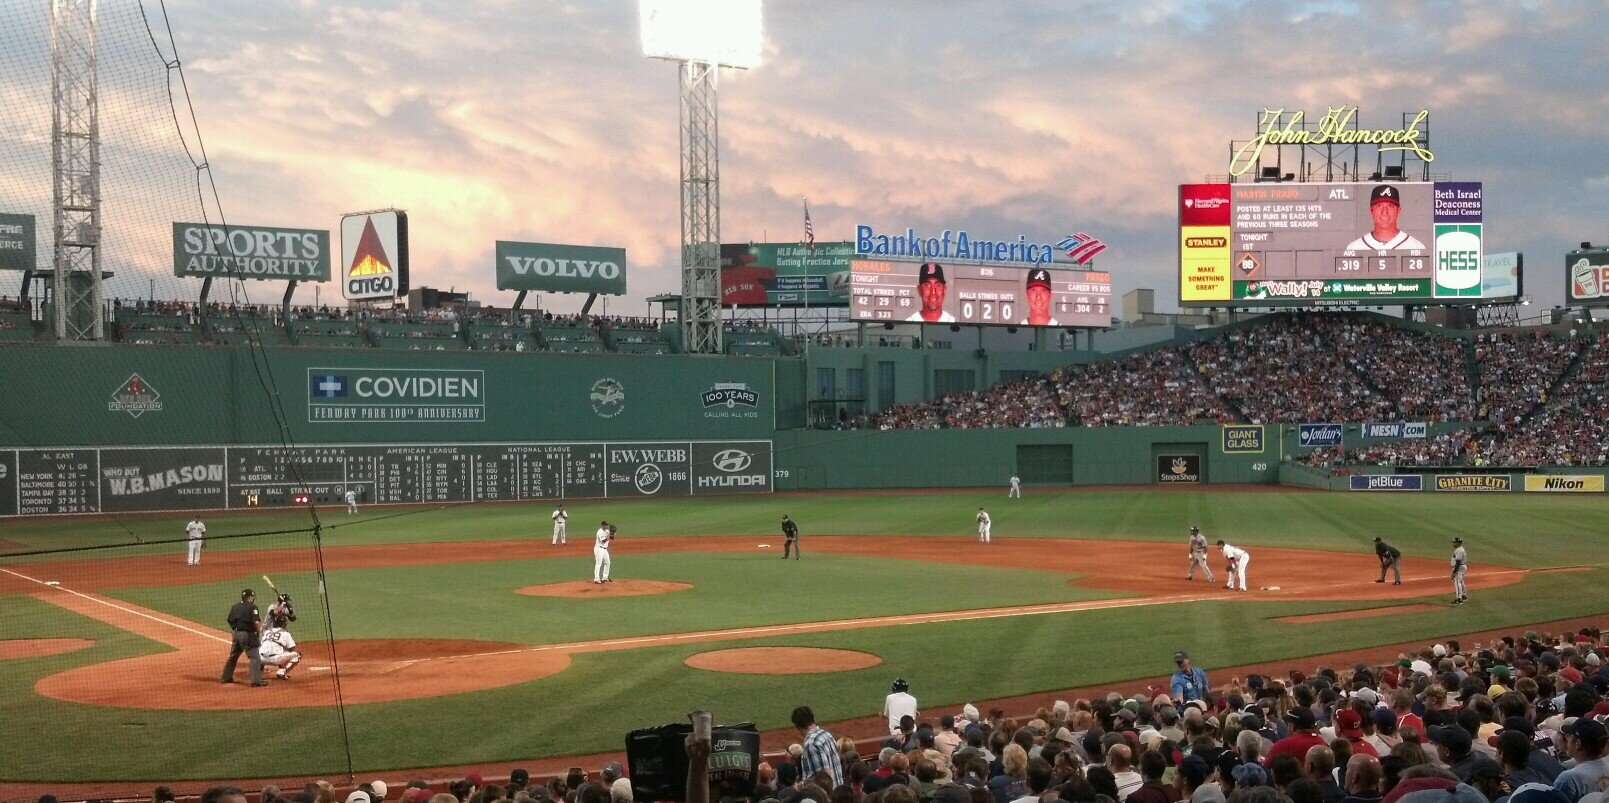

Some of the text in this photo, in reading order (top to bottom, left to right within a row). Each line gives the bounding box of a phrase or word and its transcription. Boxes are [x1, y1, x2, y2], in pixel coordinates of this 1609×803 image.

[1230, 104, 1434, 176] John Hancock
[1329, 189, 1349, 200] ATL
[1435, 190, 1481, 199] Beth Israel
[1435, 200, 1480, 208] Deaconess
[184, 227, 319, 259] SPORTS
[855, 224, 1053, 264] Bank of America
[777, 257, 849, 267] Batting Practice Jers
[1338, 259, 1423, 270] .319 5 28
[1439, 250, 1477, 270] HESS
[1483, 257, 1511, 267] TRAVEL
[506, 256, 619, 280] VOLVO
[851, 274, 879, 282] TONIGHT
[348, 277, 393, 295] CITGO
[1068, 284, 1090, 292] CAREER
[1100, 285, 1111, 293] BOS
[1267, 281, 1308, 297] Wally!
[1308, 281, 1324, 290] July
[1343, 283, 1376, 292] Waterville
[1376, 283, 1397, 293] Valley
[1397, 283, 1419, 292] Resort
[858, 297, 868, 305] 42
[879, 298, 889, 306] 29
[963, 303, 1011, 320] 0 2 0
[1074, 304, 1090, 313] .304
[1098, 305, 1104, 313] 2
[355, 377, 478, 398] COVIDIEN
[706, 391, 755, 402] 100 YEARS
[315, 408, 356, 418] FENWAY
[361, 408, 386, 418] PARK
[418, 408, 480, 418] ANNIVERSARY
[1228, 430, 1257, 439] GIANT
[1307, 425, 1341, 445] Jordan's
[1370, 425, 1400, 436] NESN
[1227, 439, 1259, 448] GLASS
[610, 449, 686, 464] F.W. WEBB
[103, 467, 140, 477] WHO BUT
[1252, 463, 1267, 471] 420
[668, 471, 686, 481] 1866
[775, 470, 789, 478] 379
[1161, 473, 1197, 482] Stop&Shop
[698, 475, 766, 487] HYUNDAI
[1367, 476, 1403, 488] jetBlue
[1438, 476, 1483, 488] GRANITE
[1544, 478, 1584, 489] Nikon
[247, 494, 258, 505] 14
